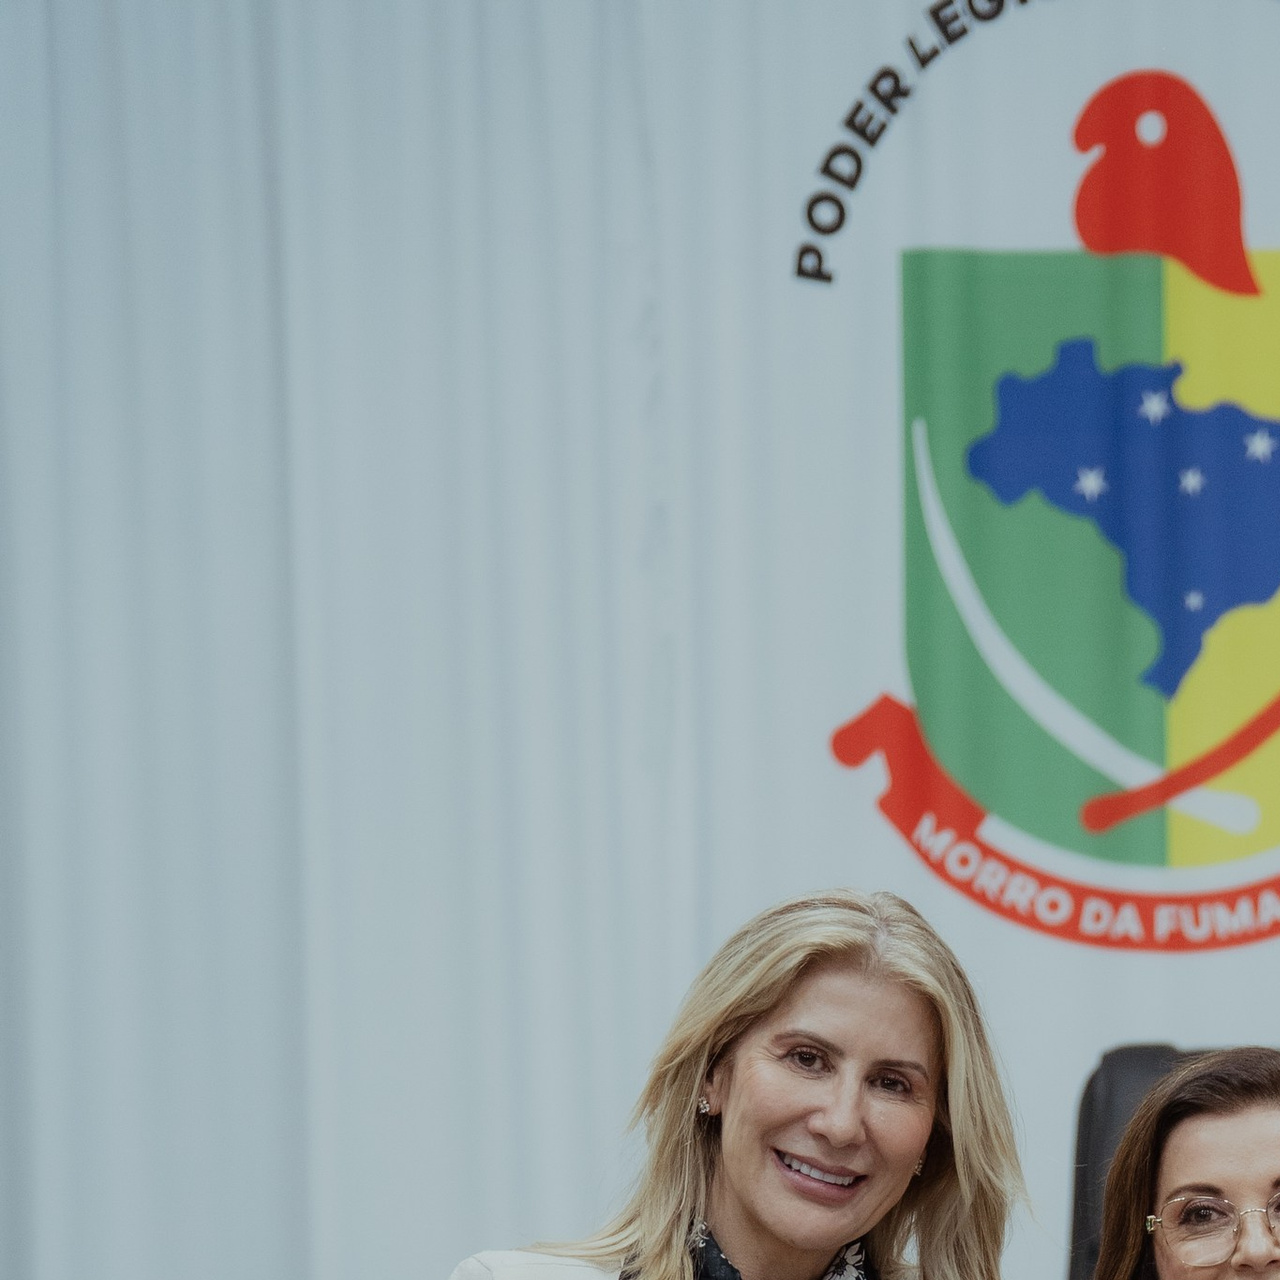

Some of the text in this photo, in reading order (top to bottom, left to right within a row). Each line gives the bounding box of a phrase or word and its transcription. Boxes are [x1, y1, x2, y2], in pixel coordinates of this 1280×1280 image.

[796, 66, 911, 283] PODER
[907, 0, 1028, 68] LEG
[911, 812, 1074, 926] MORRO
[1079, 896, 1144, 942] DA
